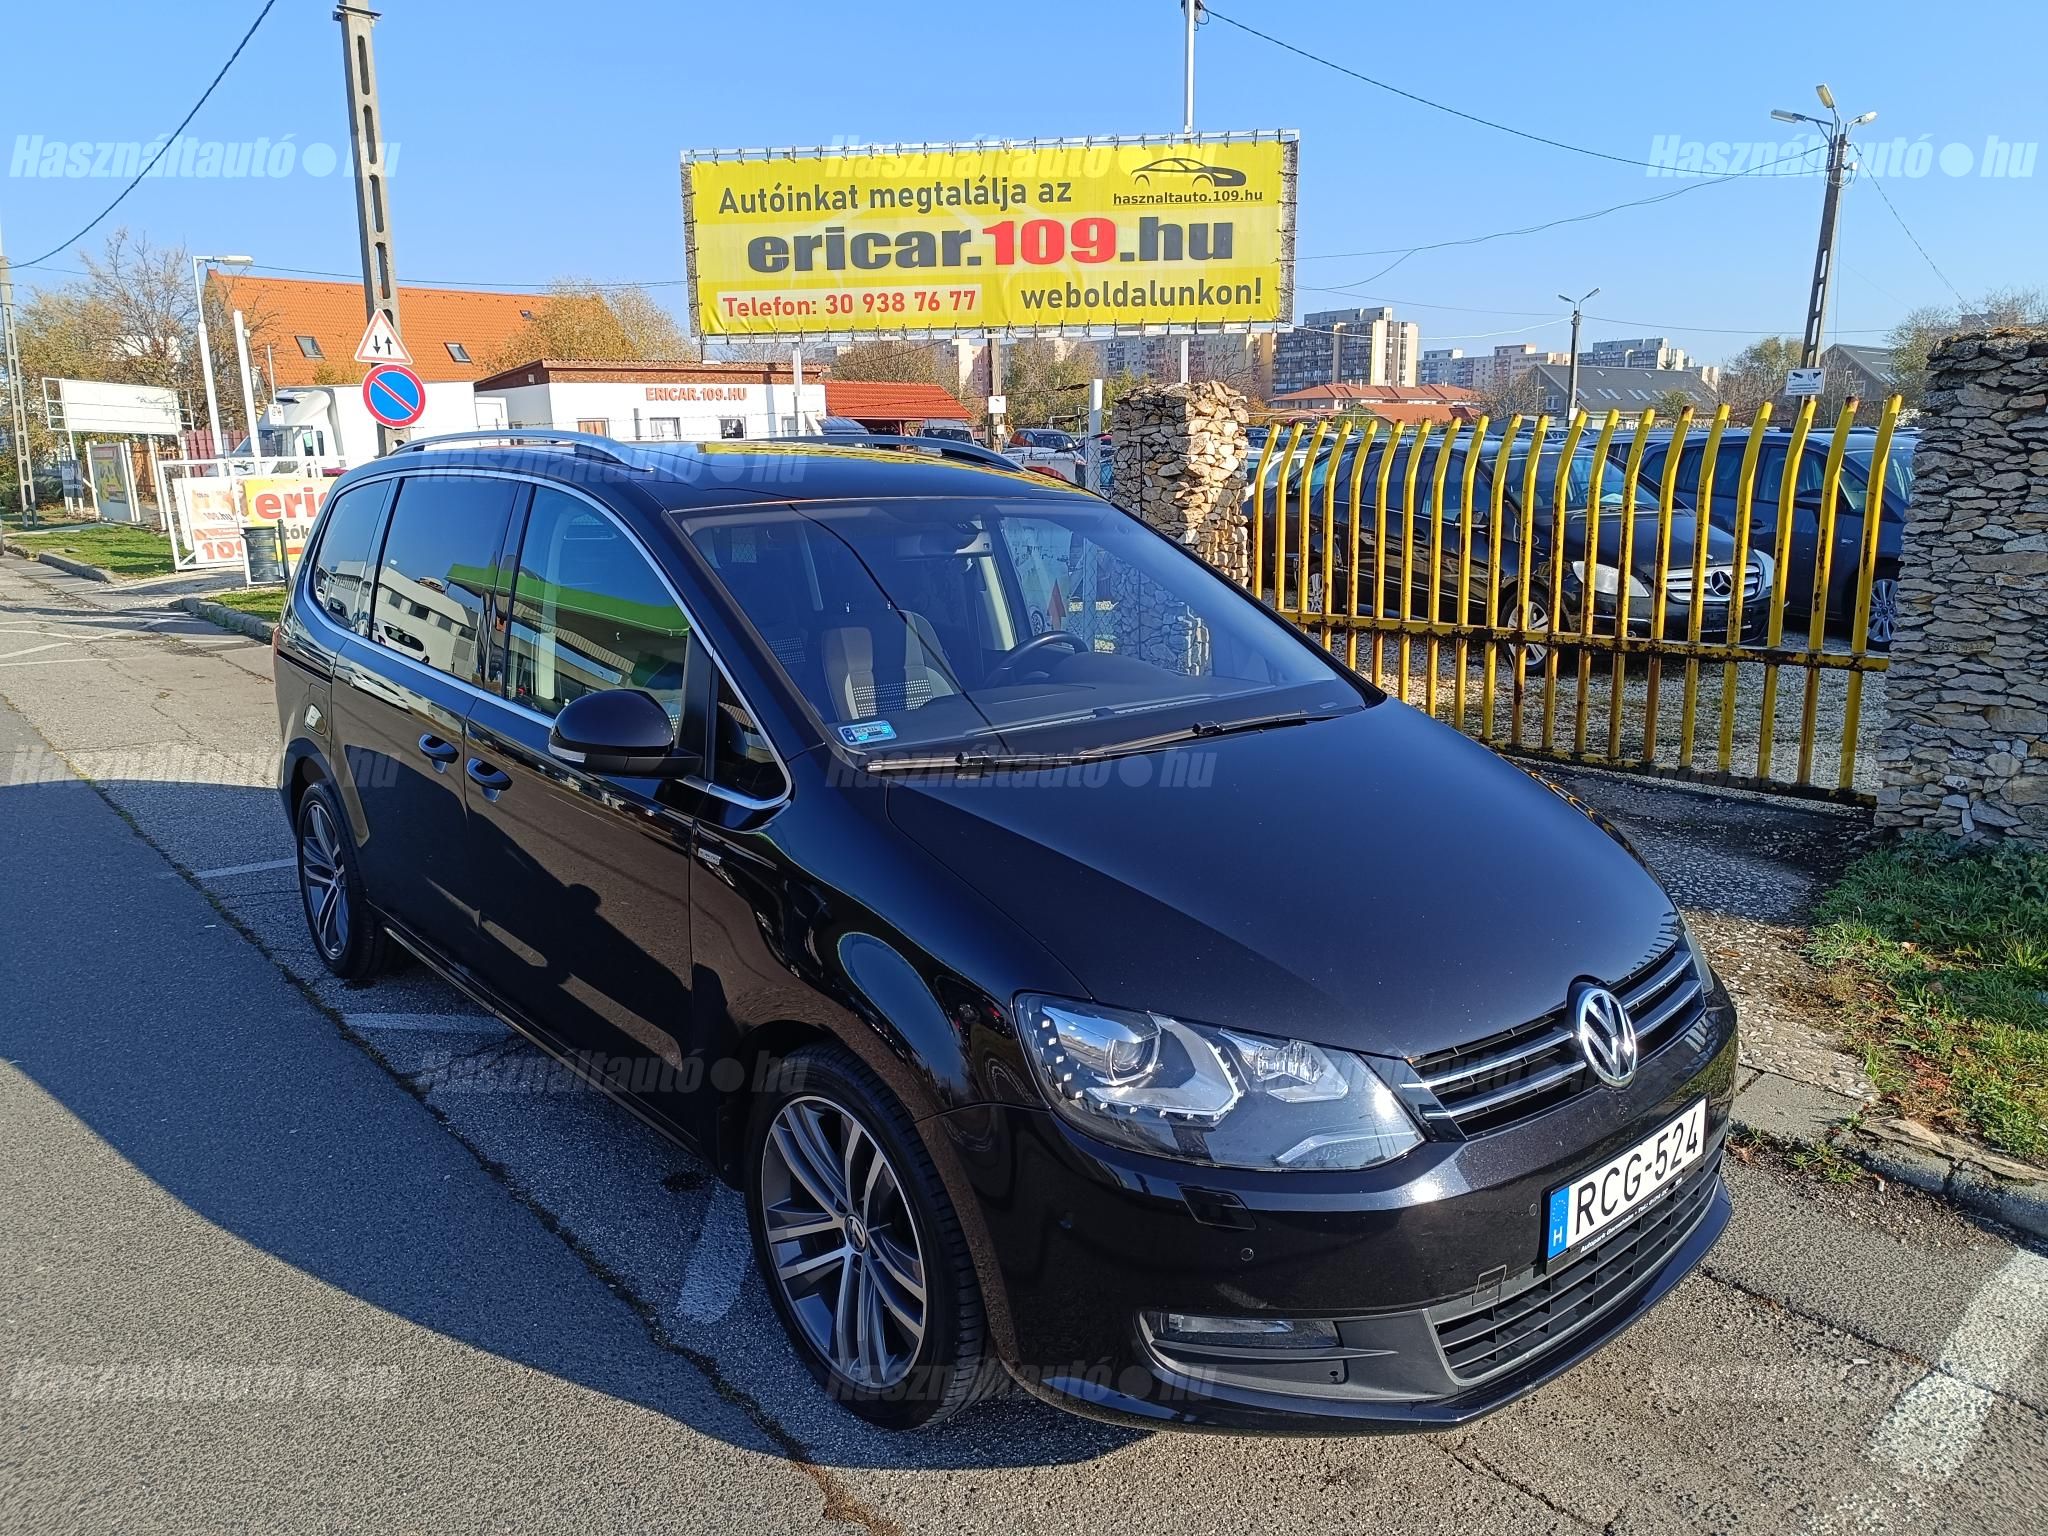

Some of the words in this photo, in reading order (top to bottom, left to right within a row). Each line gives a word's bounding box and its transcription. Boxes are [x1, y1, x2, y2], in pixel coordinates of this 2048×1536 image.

[719, 183, 858, 214] Autóinkat
[869, 174, 1026, 213] megtalálja
[1038, 181, 1072, 203] az
[1113, 189, 1263, 205] hasznaltauto.109.hu
[747, 216, 1233, 273] ericar.109.hu
[722, 297, 817, 317] Telefon:
[825, 293, 854, 315] 30
[862, 292, 905, 313] 938
[914, 291, 940, 312] 76
[949, 290, 976, 311] 77
[1020, 277, 1261, 309] weboldalunkon!
[645, 387, 747, 401] ERICAR.109.HU
[1575, 1111, 1698, 1236] RCG-524
[1553, 1225, 1563, 1248] H
